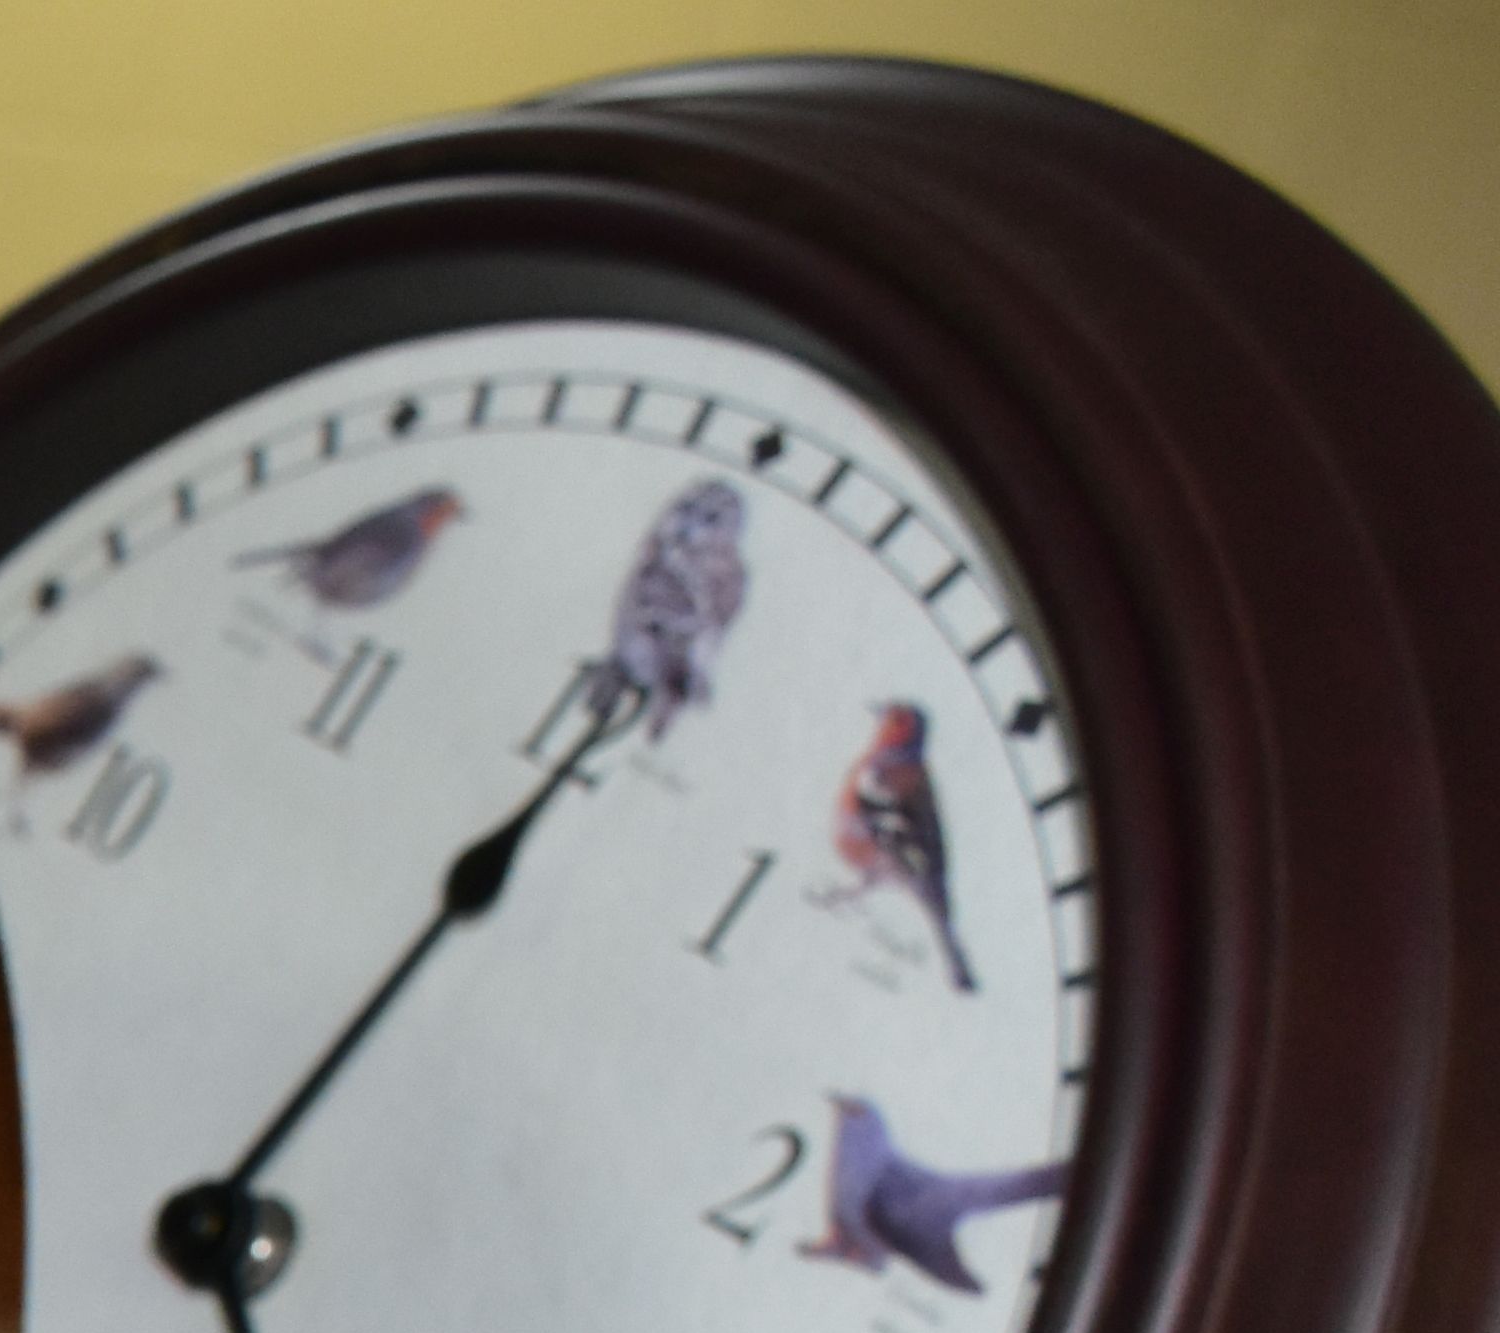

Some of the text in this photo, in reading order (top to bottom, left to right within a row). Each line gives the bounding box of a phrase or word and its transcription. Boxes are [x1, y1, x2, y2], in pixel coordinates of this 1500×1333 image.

[302, 636, 405, 757] 11
[65, 742, 172, 860] 10
[684, 848, 777, 965] 1
[702, 1122, 807, 1246] 2
